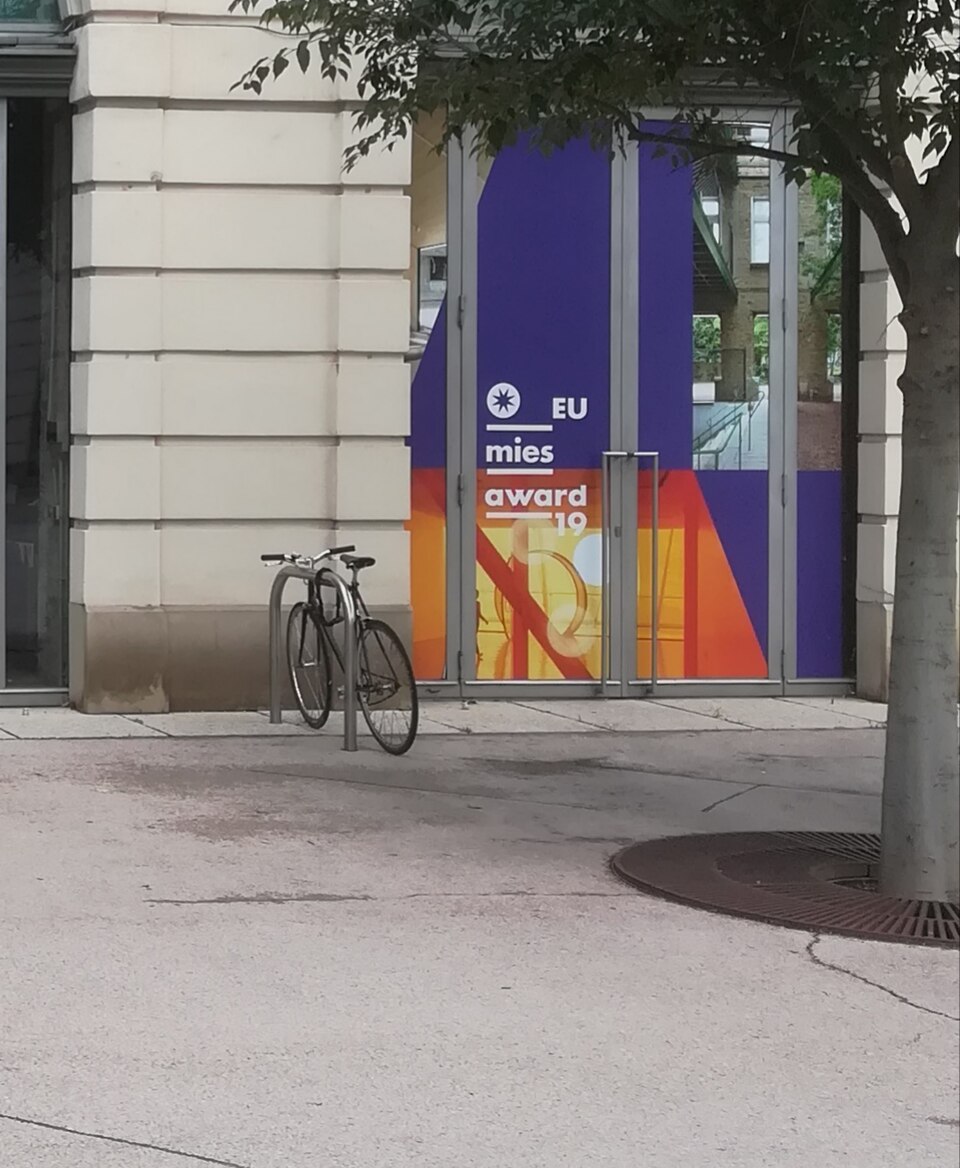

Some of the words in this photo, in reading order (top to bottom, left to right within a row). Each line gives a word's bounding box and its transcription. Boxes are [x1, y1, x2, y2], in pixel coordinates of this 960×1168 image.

[552, 397, 588, 420] EU
[486, 436, 554, 463] mies
[484, 484, 587, 507] award
[554, 511, 588, 537] 19
